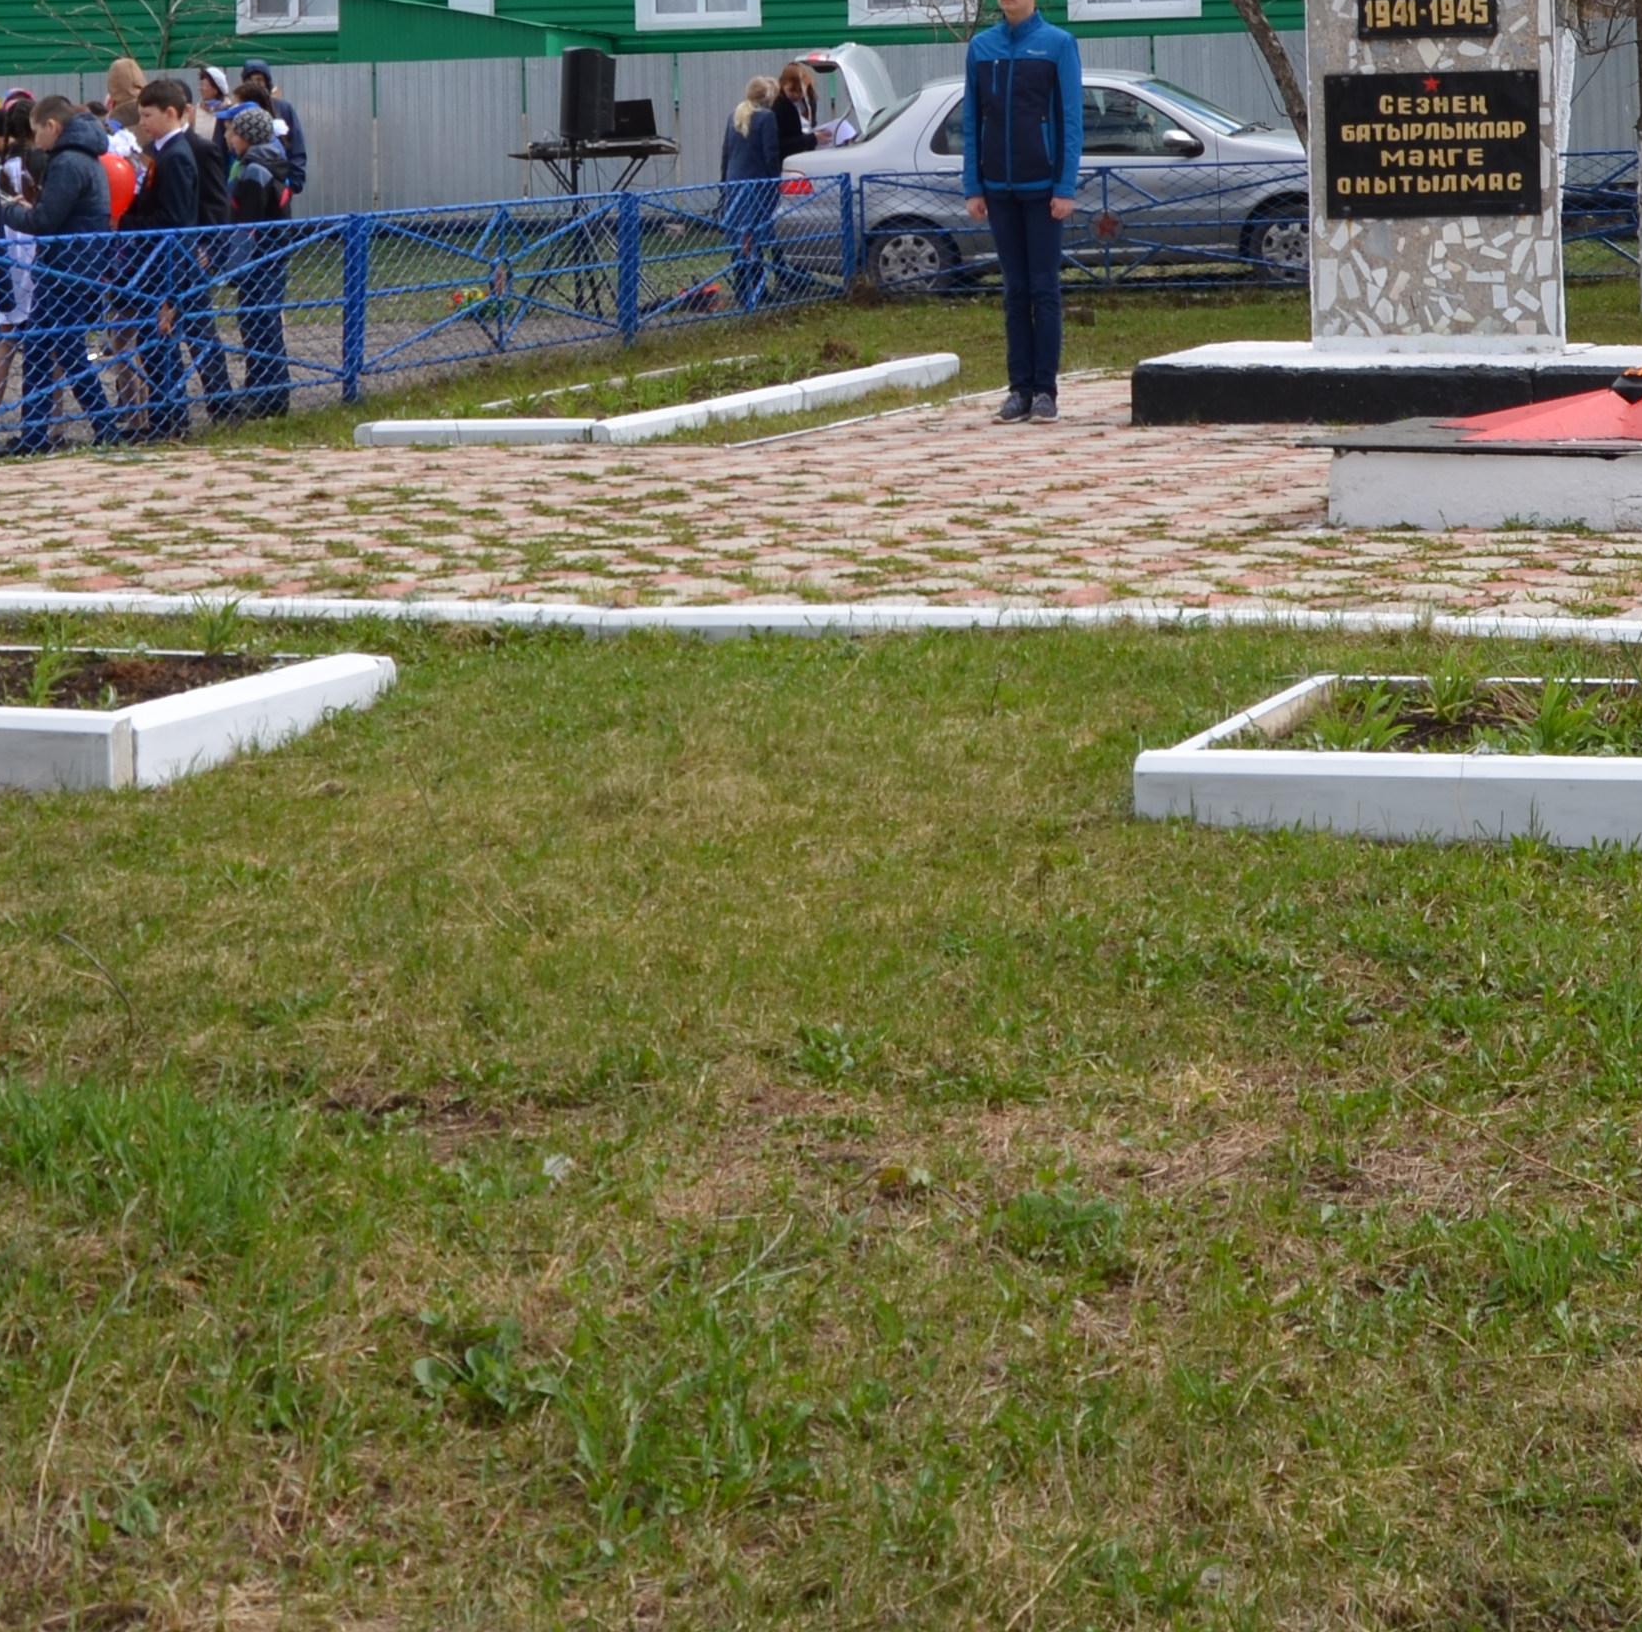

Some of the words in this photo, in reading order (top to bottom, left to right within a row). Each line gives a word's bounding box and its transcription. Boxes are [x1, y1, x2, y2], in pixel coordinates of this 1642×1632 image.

[1379, 94, 1488, 115] СЕЗНЕҢ
[1341, 120, 1526, 142] БАТЫРЛЫКЛАР
[1337, 172, 1522, 195] ОНЫТЫЛМАС
